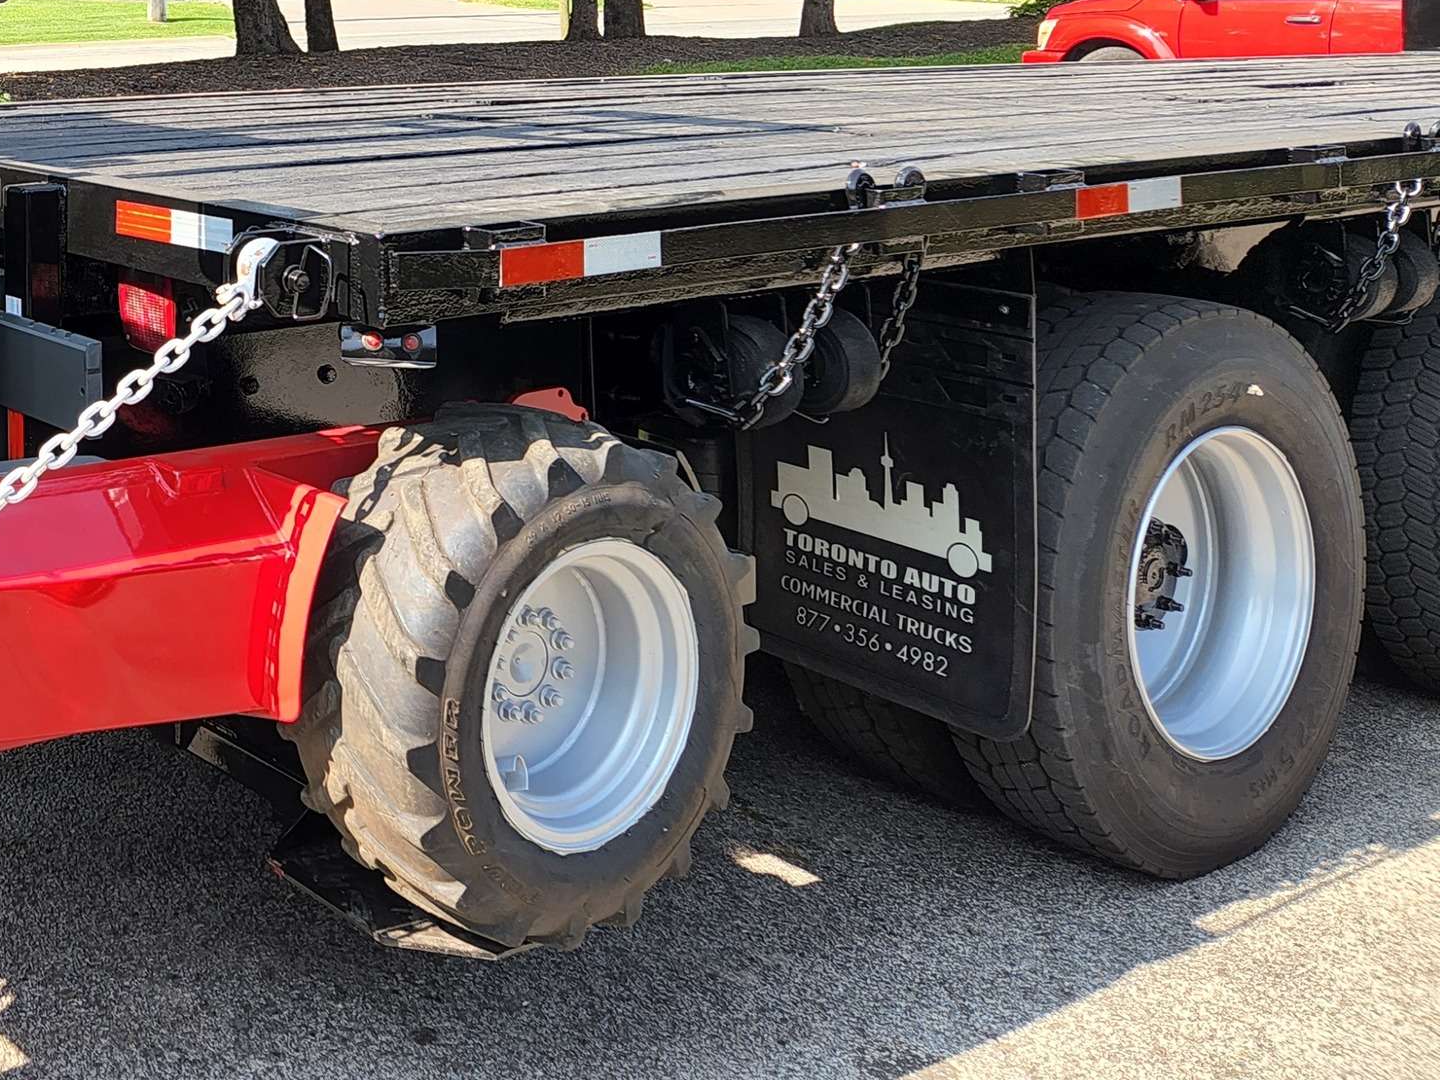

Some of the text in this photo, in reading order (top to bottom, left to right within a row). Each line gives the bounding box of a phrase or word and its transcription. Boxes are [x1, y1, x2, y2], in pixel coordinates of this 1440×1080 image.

[783, 527, 977, 605] TORONTO AUTO
[785, 550, 975, 624] SALES & LEASING
[780, 575, 973, 654] COMMERCIAL TRUCKS
